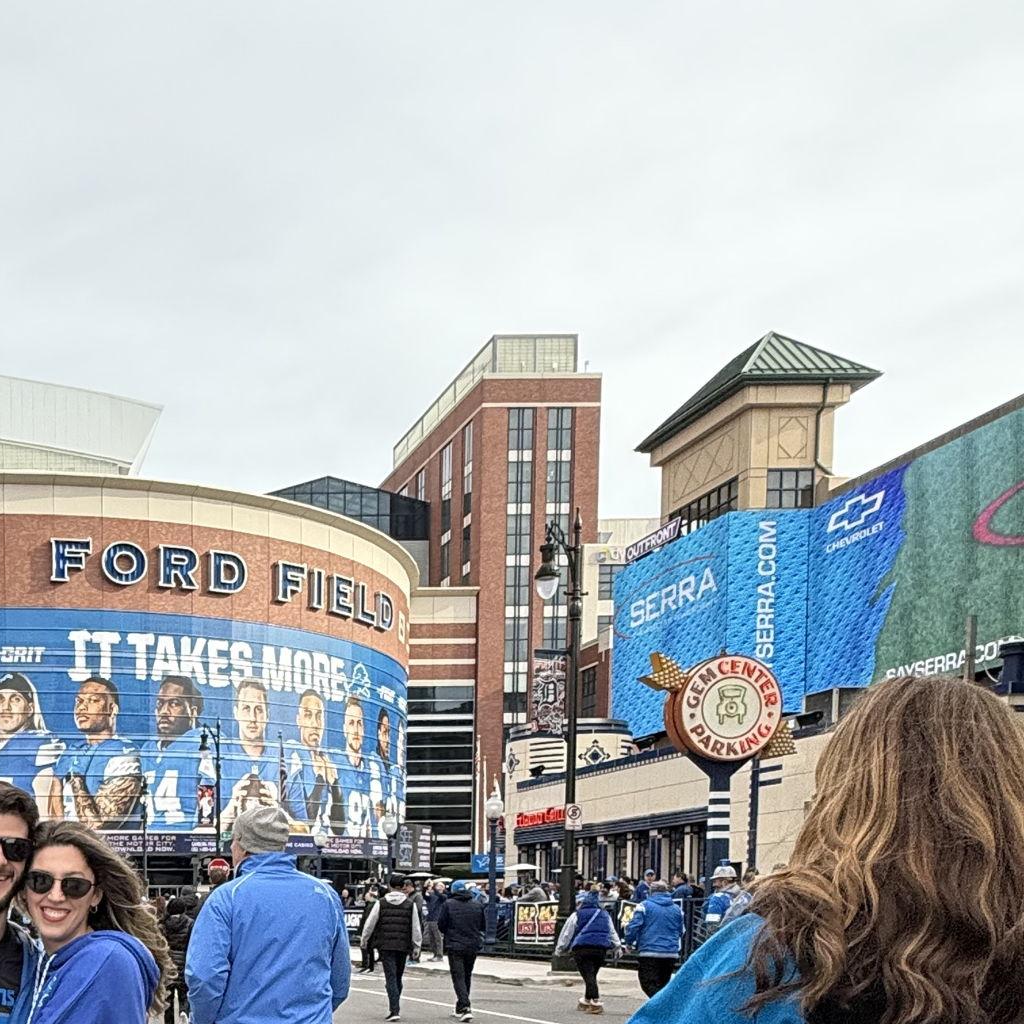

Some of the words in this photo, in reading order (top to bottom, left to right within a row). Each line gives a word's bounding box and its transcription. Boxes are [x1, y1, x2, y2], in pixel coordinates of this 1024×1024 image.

[627, 522, 675, 560] OUTFRONT
[826, 521, 884, 553] CHEVROLET
[50, 537, 248, 595] FORD
[275, 559, 394, 631] FIELD
[629, 567, 718, 628] SERRA
[756, 521, 776, 669] SERRA.COM
[0, 646, 46, 663] GRIT
[67, 628, 122, 682] IT
[127, 630, 257, 687] TAKES
[261, 643, 345, 702] MORE
[686, 666, 717, 709] GEM
[717, 659, 778, 708] CENTER
[689, 723, 772, 756] PARKING
